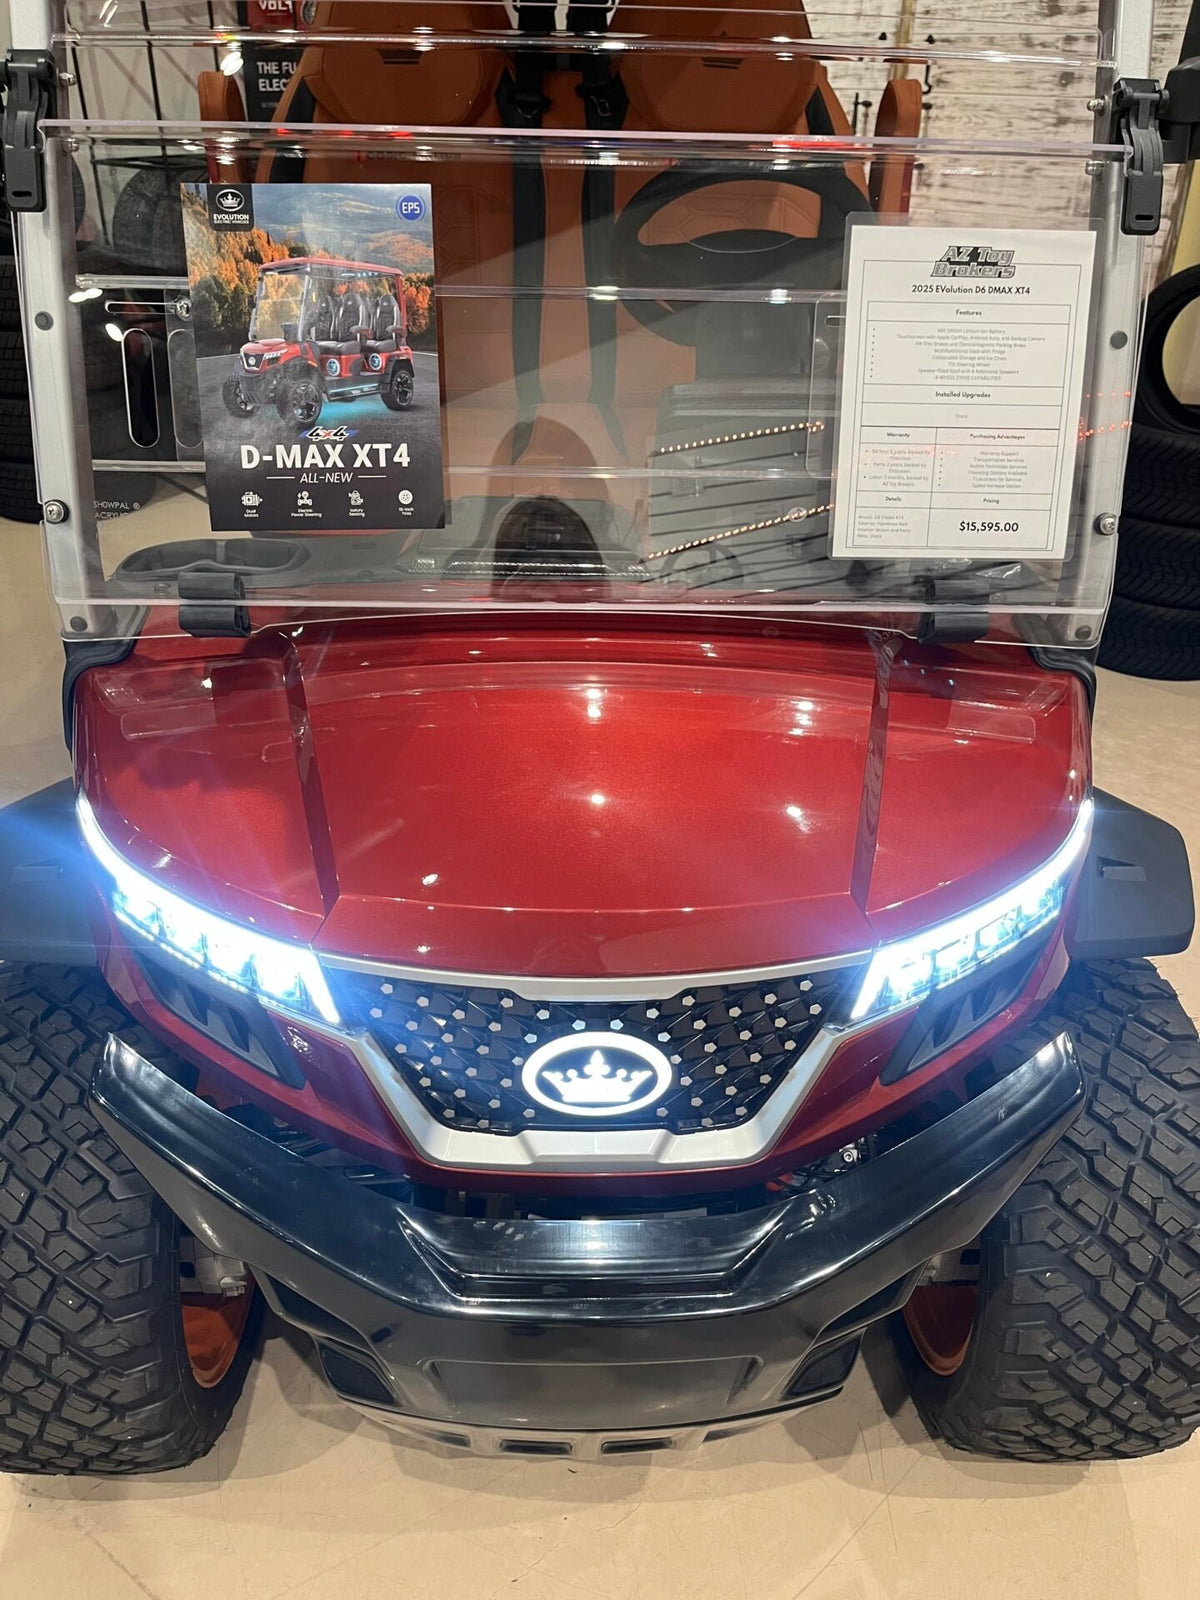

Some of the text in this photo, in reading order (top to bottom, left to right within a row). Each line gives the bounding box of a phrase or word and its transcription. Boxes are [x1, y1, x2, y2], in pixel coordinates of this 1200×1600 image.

[257, 62, 280, 74] THE
[402, 202, 420, 214] EPS
[940, 246, 1015, 266] AZ Toy
[931, 260, 1016, 278] Brokers
[912, 285, 934, 293] 2025
[936, 285, 973, 294] EVolution
[306, 426, 350, 441] 4x4
[240, 443, 411, 469] D-MAX XT4
[300, 472, 353, 484] ALL-NEW
[93, 501, 130, 509] SHOWPAL
[959, 520, 1018, 533] $15,595.00
